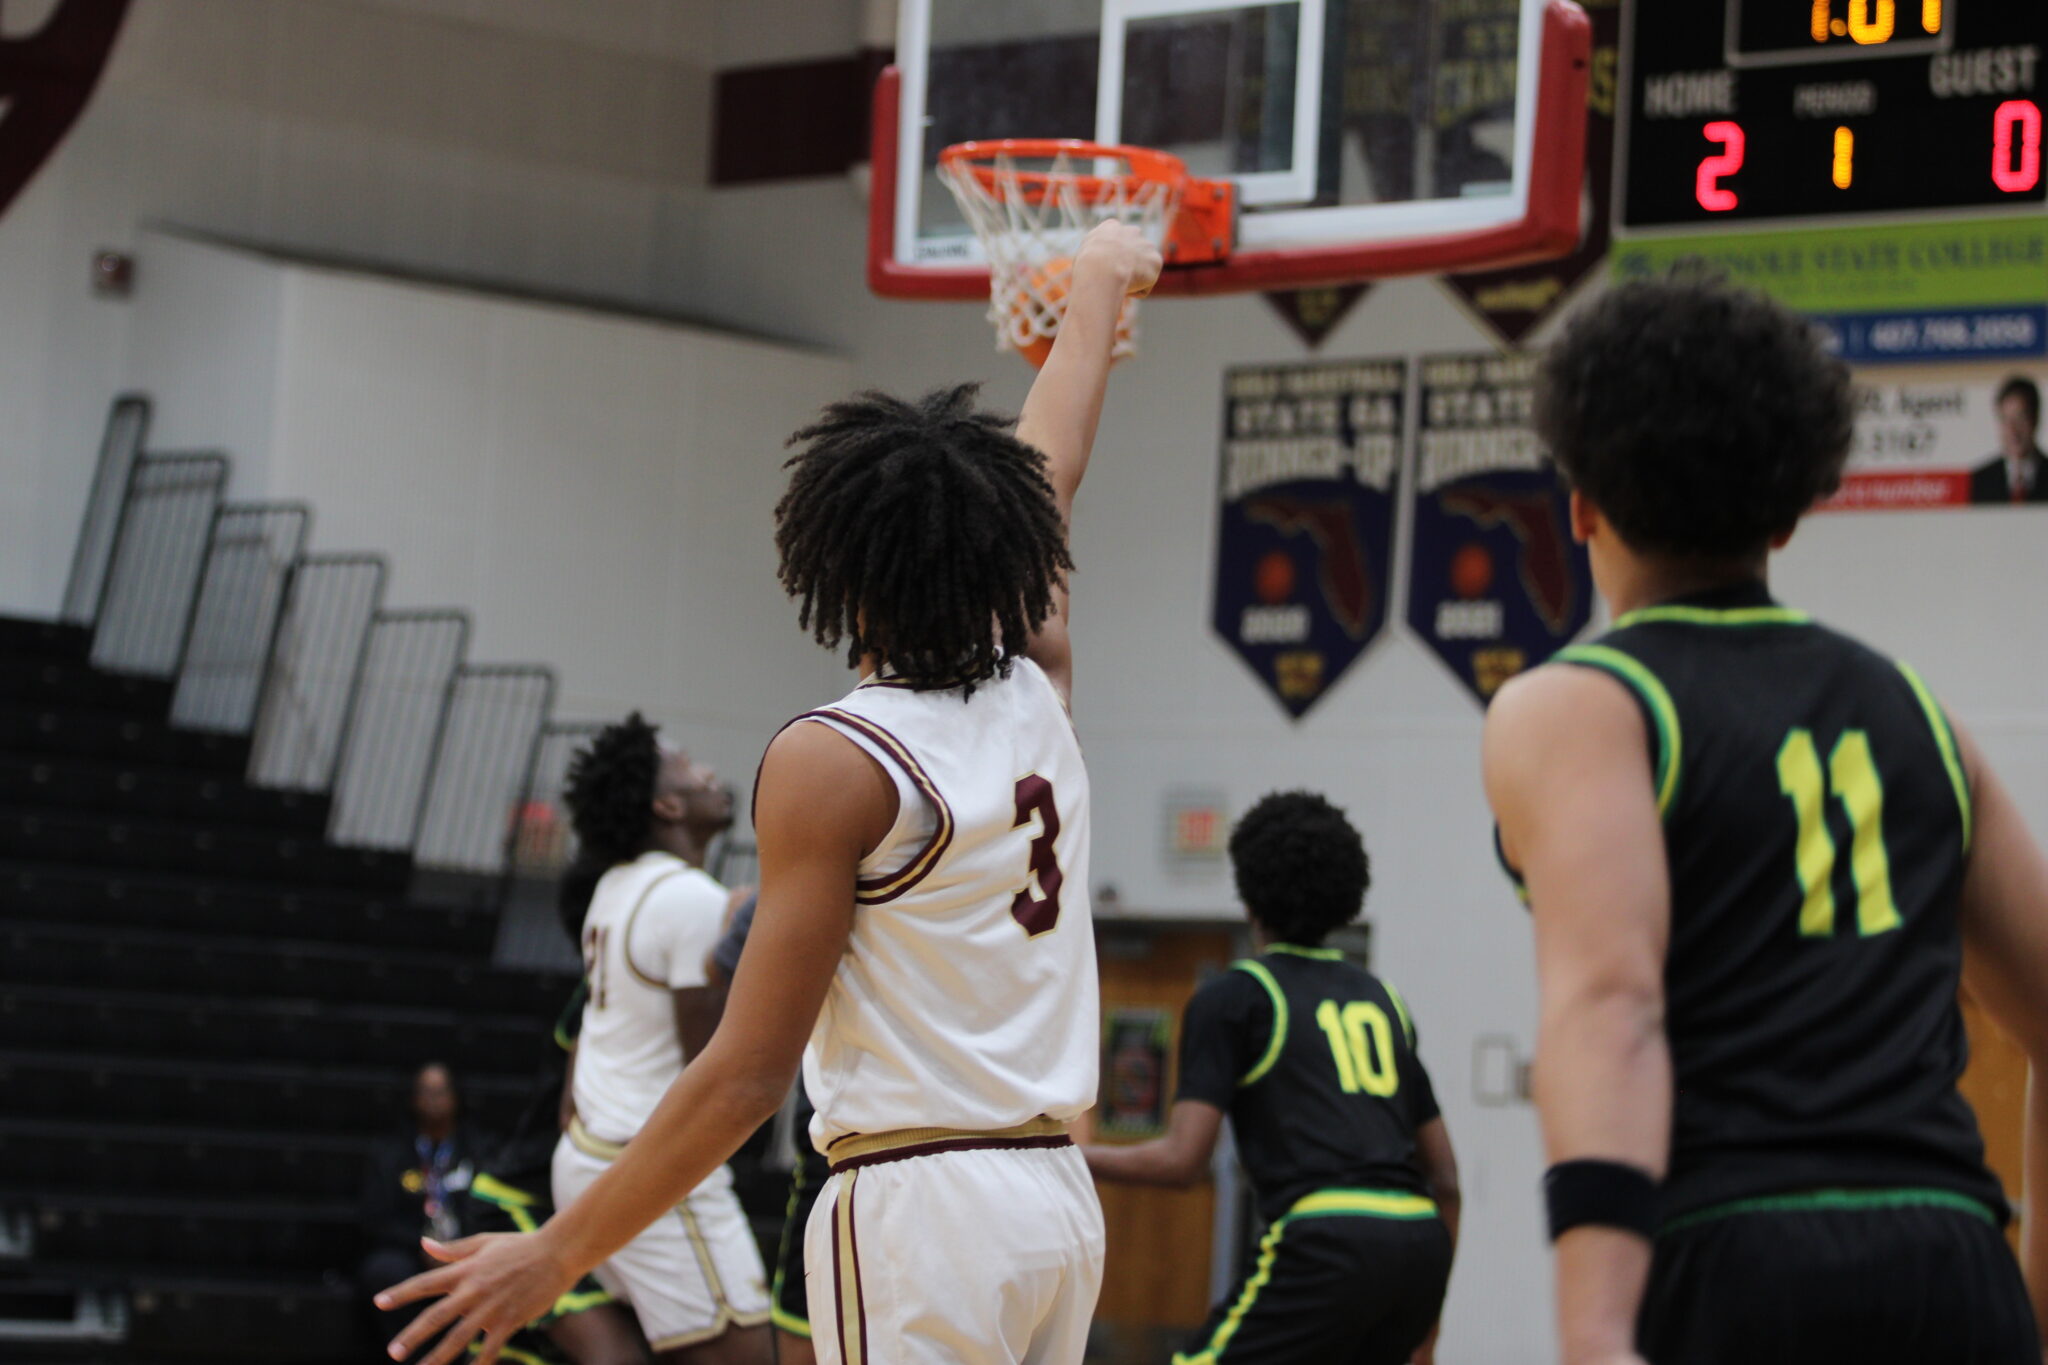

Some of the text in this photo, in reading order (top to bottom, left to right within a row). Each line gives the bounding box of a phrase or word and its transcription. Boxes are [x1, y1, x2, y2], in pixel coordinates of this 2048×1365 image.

[1645, 72, 1736, 116] HOME
[1932, 46, 2039, 98] GUEST
[1696, 121, 1745, 211] 2
[1832, 125, 1854, 189] 1
[1991, 100, 2042, 192] 0
[1010, 771, 1063, 940] 3
[1775, 726, 1903, 938] 11
[1315, 999, 1399, 1098] 10
